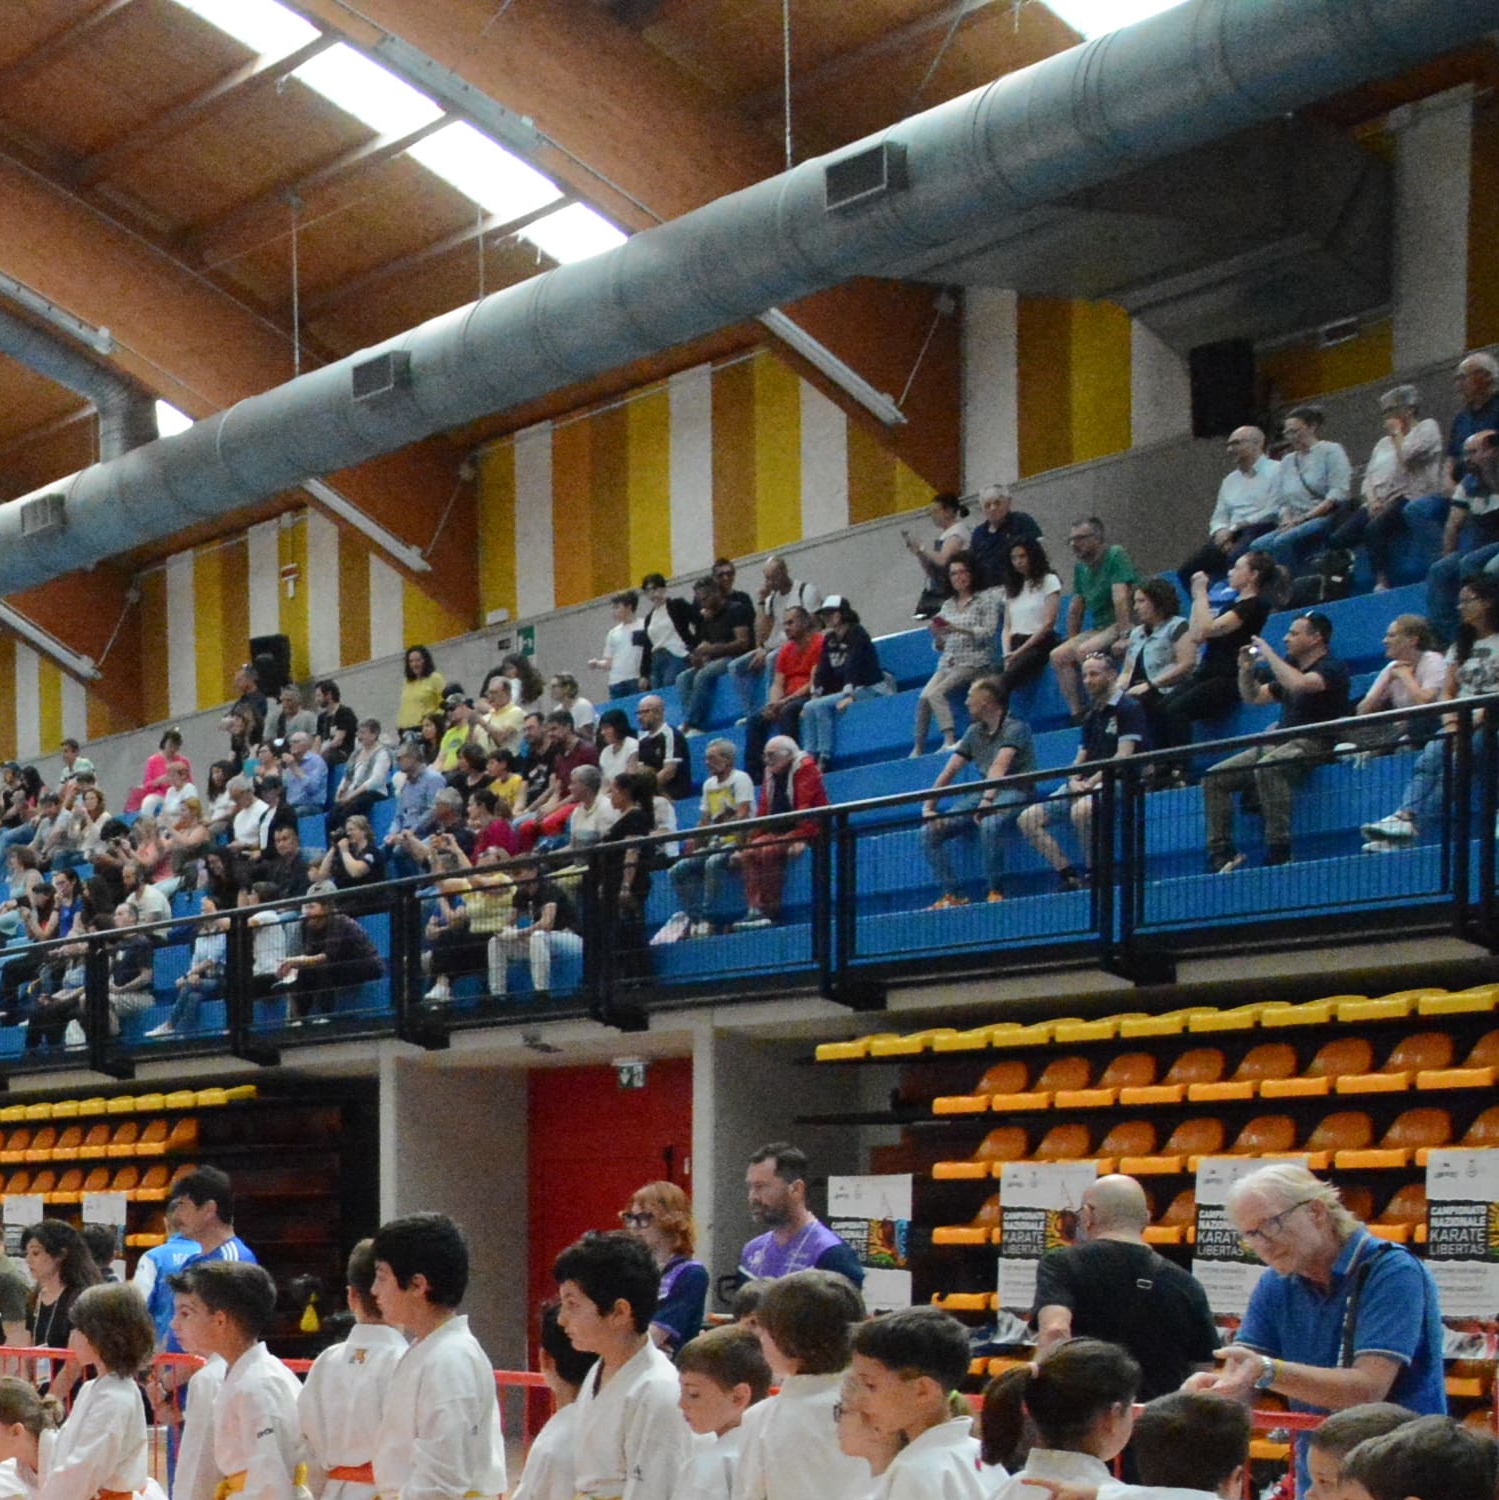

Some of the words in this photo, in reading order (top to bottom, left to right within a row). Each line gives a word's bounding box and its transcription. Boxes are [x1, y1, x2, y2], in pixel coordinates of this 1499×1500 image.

[1002, 1231, 1044, 1243] KARATE
[1197, 1231, 1238, 1244] KARAT
[1429, 1228, 1486, 1242] KARATE
[1197, 1245, 1244, 1256] LIBERTAS
[1429, 1243, 1486, 1255] LIBERTAS
